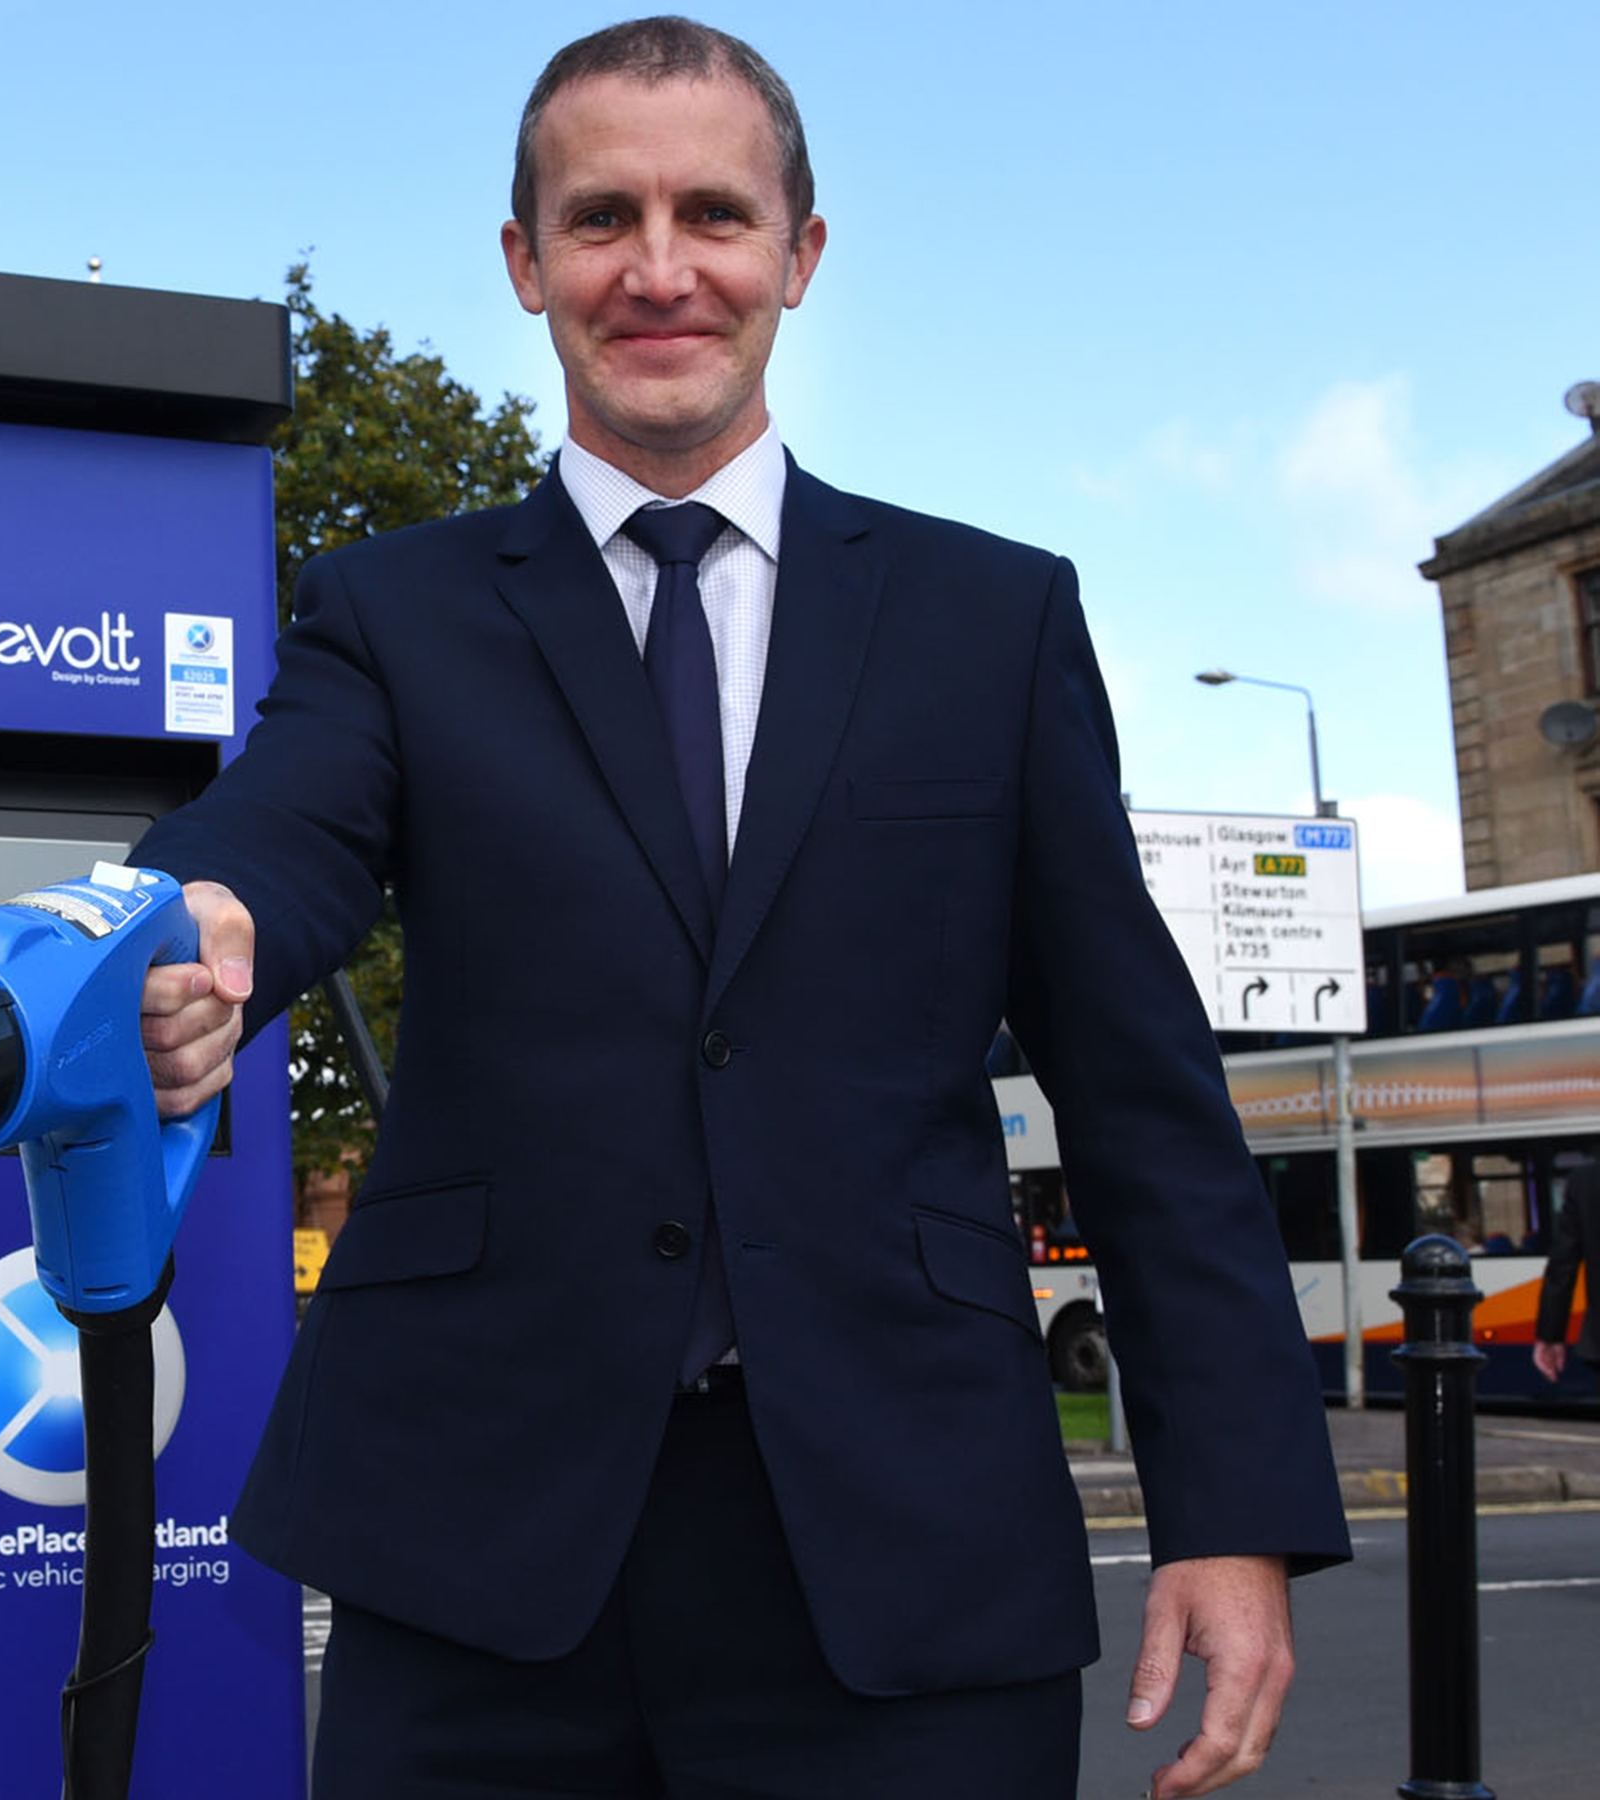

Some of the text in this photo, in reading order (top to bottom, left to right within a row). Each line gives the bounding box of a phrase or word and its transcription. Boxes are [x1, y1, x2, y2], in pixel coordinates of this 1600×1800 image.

[52, 670, 82, 684] Design
[84, 672, 94, 685] by
[1217, 826, 1286, 844] Glasgow
[1219, 857, 1247, 873] Ayr
[1222, 883, 1307, 899] Stewarton
[1225, 922, 1322, 939] Town centre
[154, 1516, 228, 1548] tland
[13, 1562, 85, 1589] vehic
[152, 1556, 229, 1587] arging
